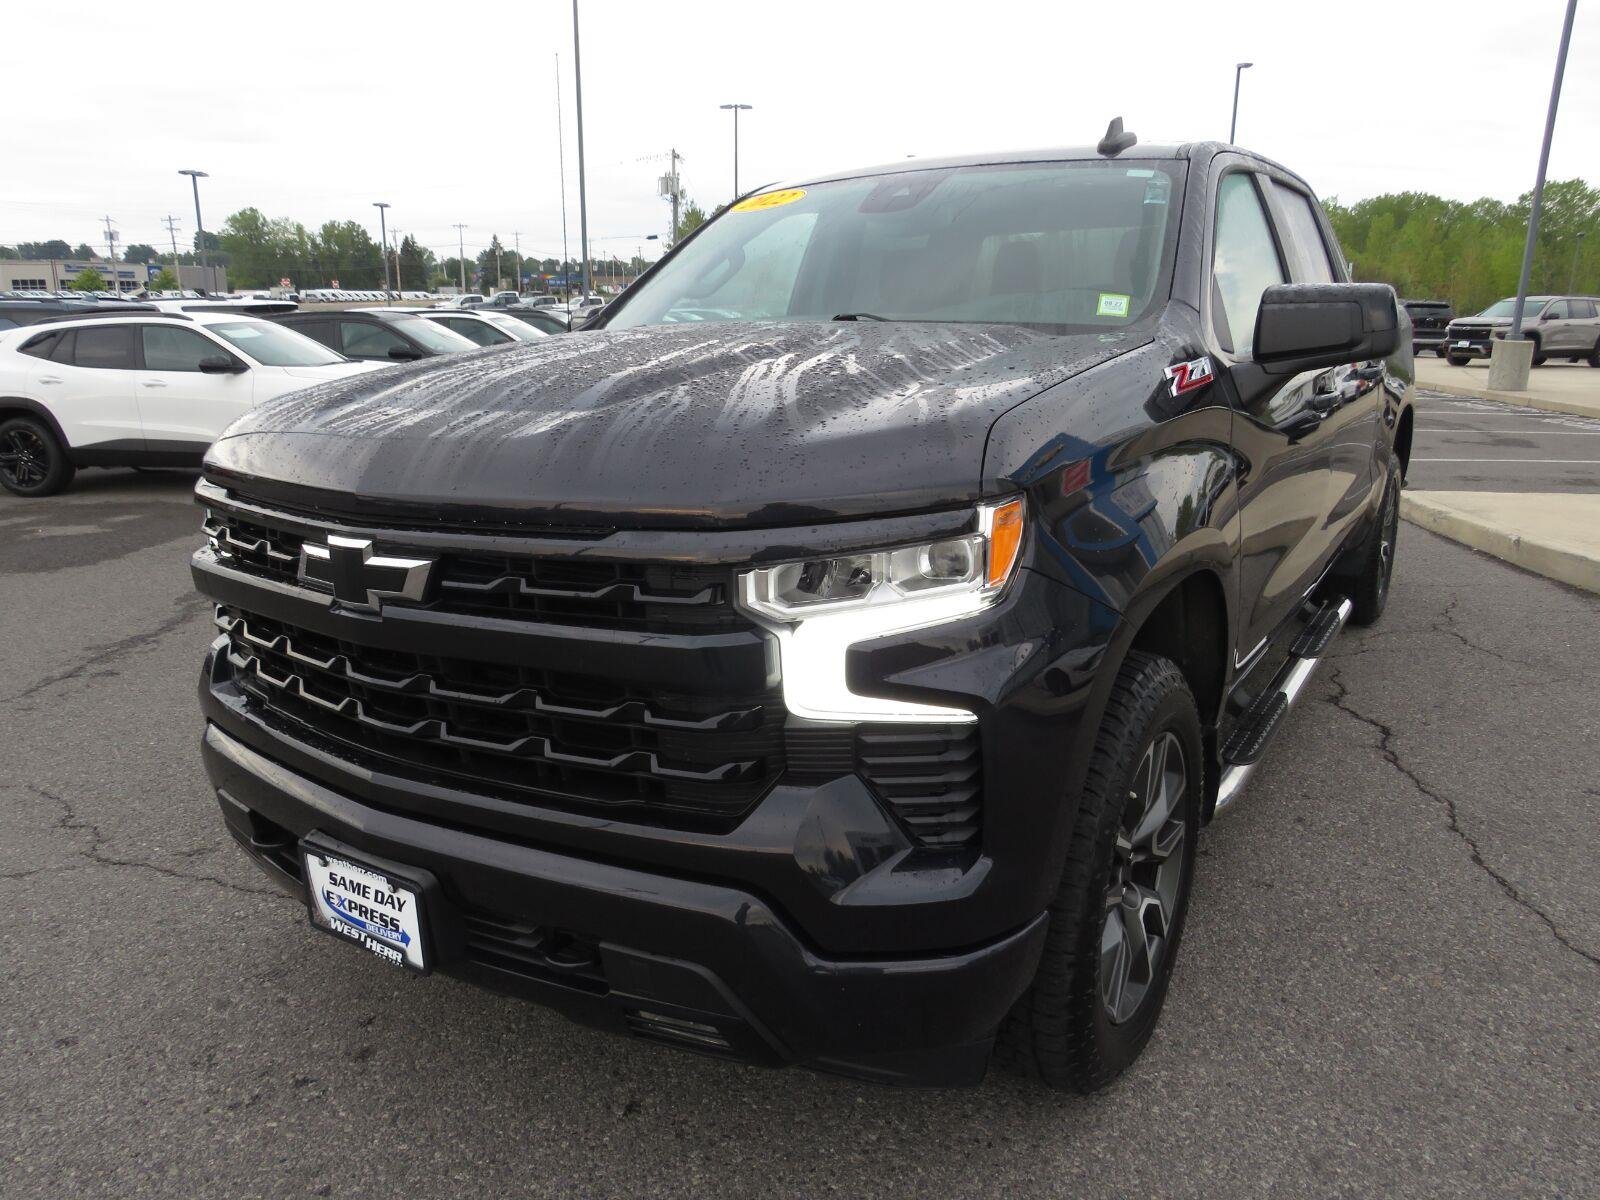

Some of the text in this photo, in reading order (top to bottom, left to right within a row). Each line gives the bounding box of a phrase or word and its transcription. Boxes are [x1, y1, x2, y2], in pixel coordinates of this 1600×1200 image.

[1163, 356, 1214, 398] Z71
[326, 890, 401, 933] EXPRESS
[328, 871, 407, 913] SAME DAY
[366, 923, 402, 943] DELIVERY
